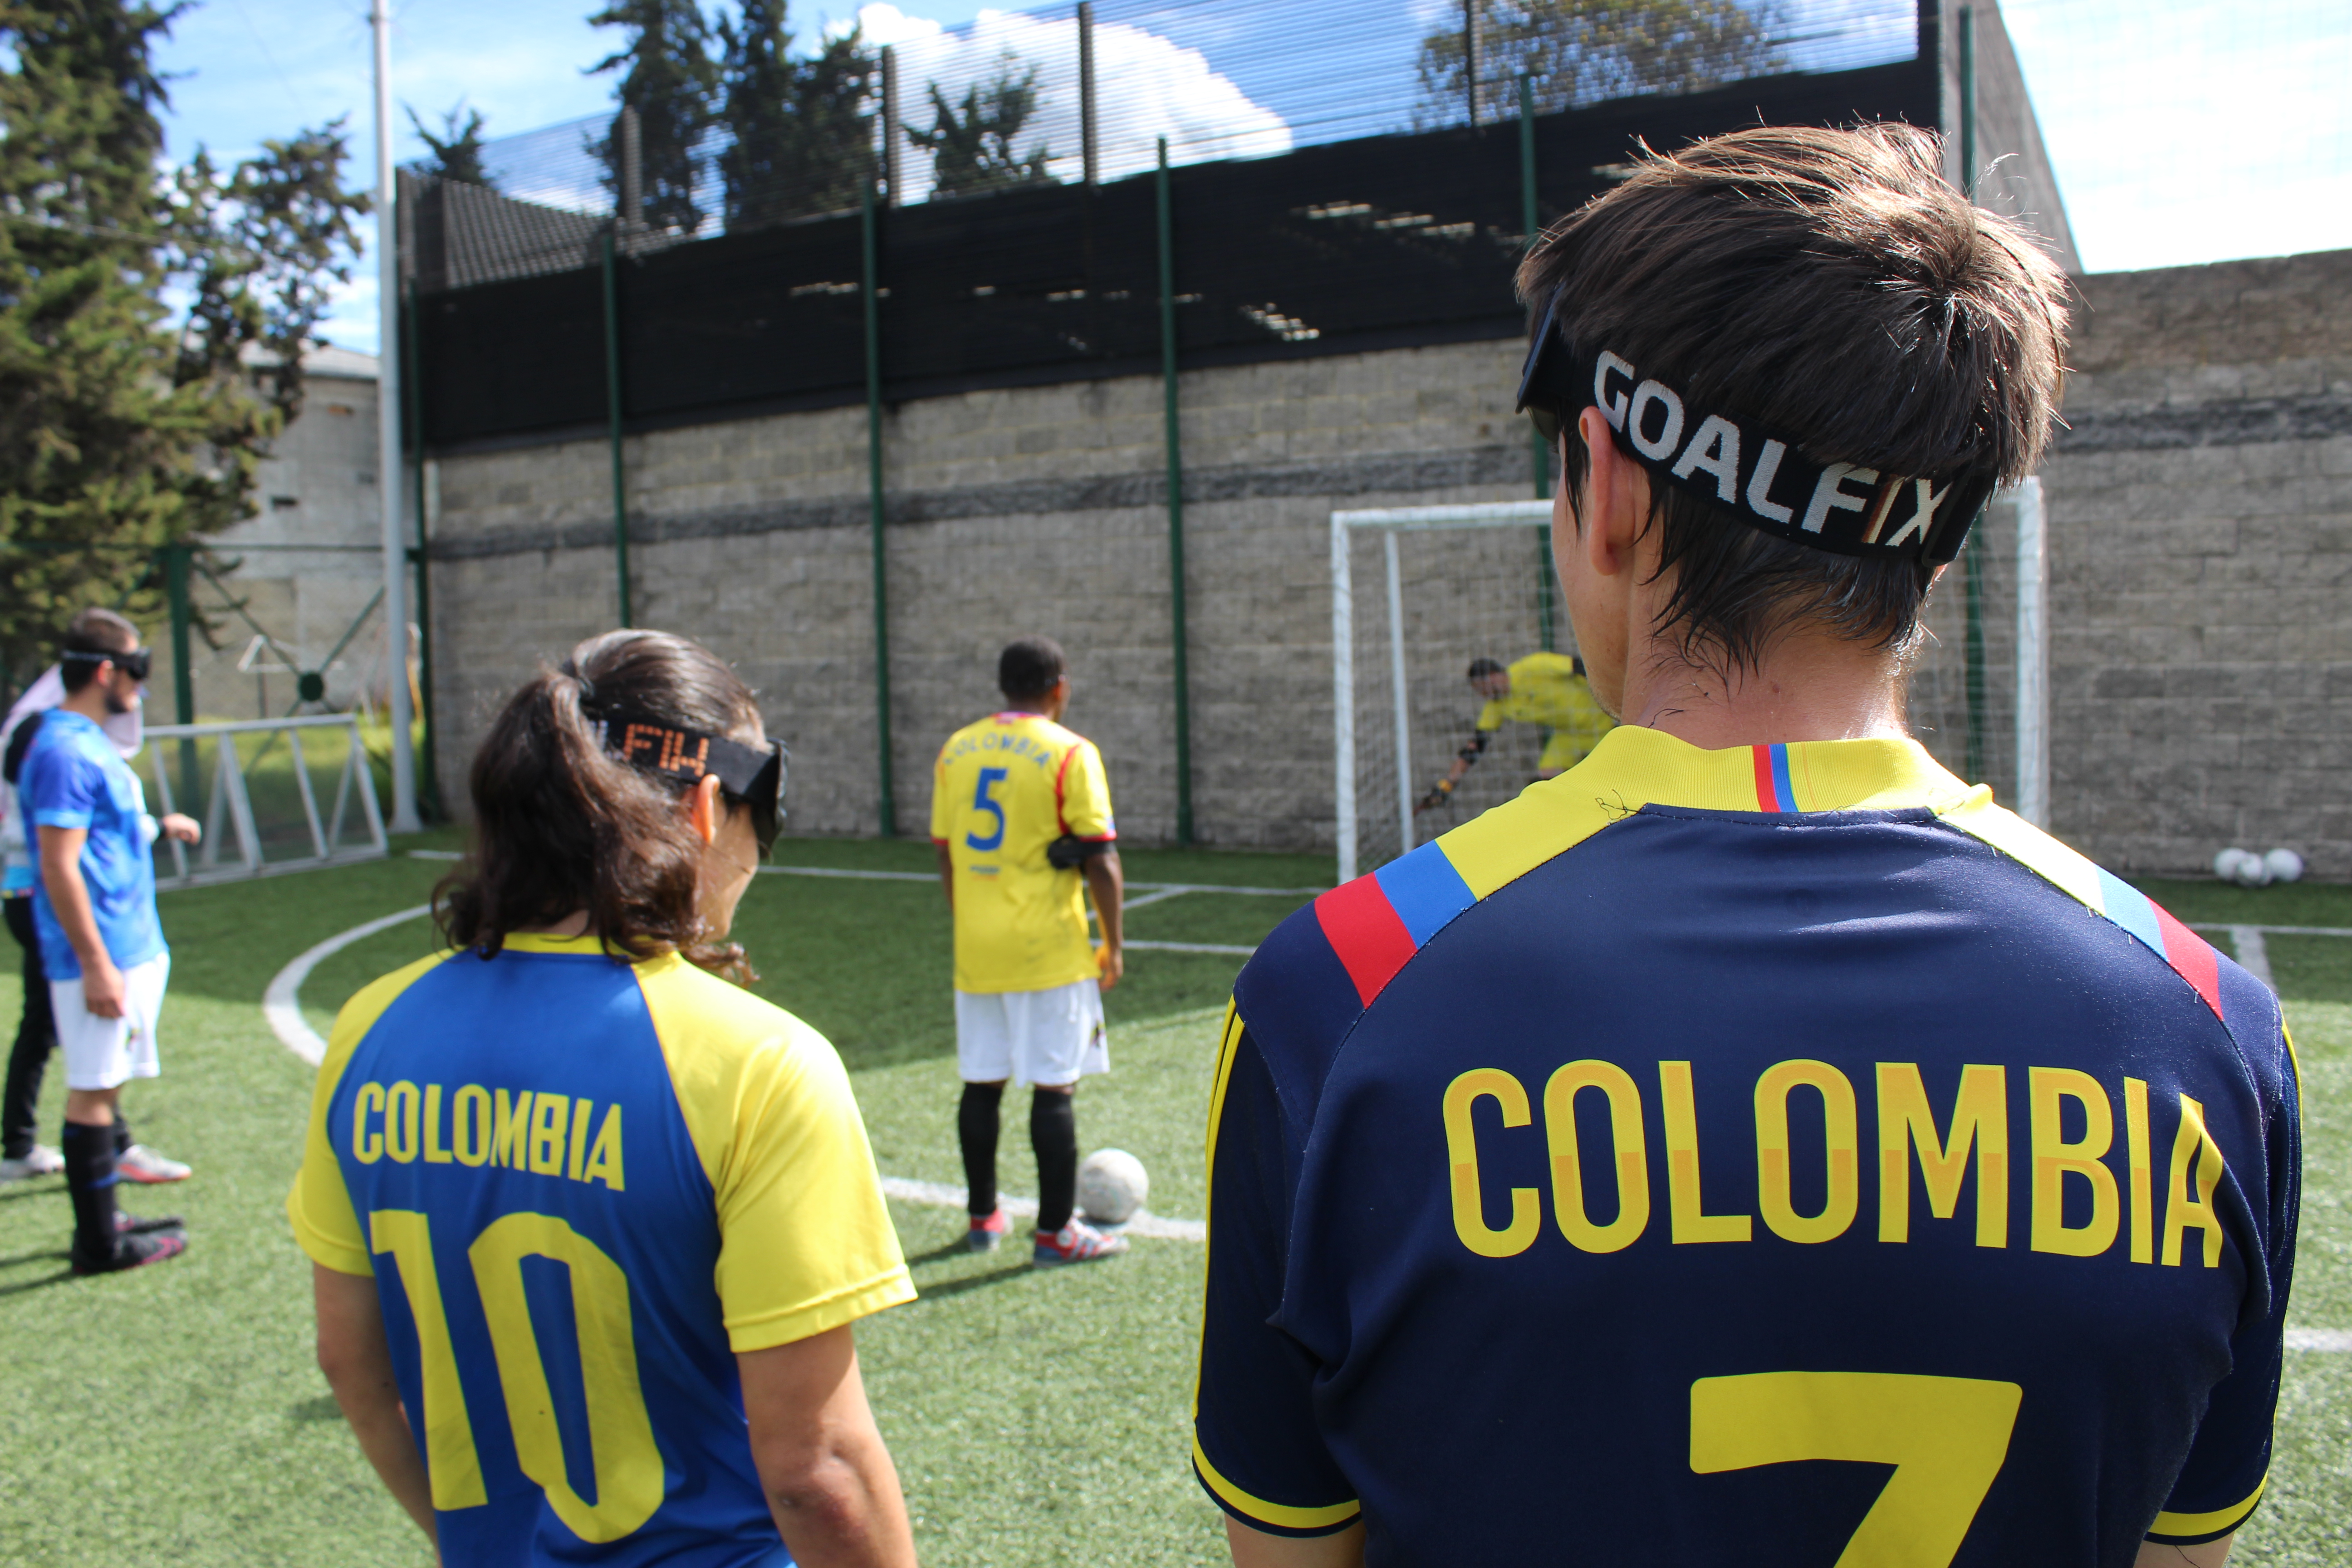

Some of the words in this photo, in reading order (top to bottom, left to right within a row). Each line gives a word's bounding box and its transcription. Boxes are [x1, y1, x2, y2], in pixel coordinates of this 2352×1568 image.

[1594, 350, 1953, 547] GOALFIX
[965, 767, 1009, 852] 5
[353, 1080, 625, 1192] COLOMBIA
[1442, 1058, 2223, 1268] COLOMBIA
[369, 1208, 665, 1544] 10
[1689, 1371, 2023, 1568] 7
